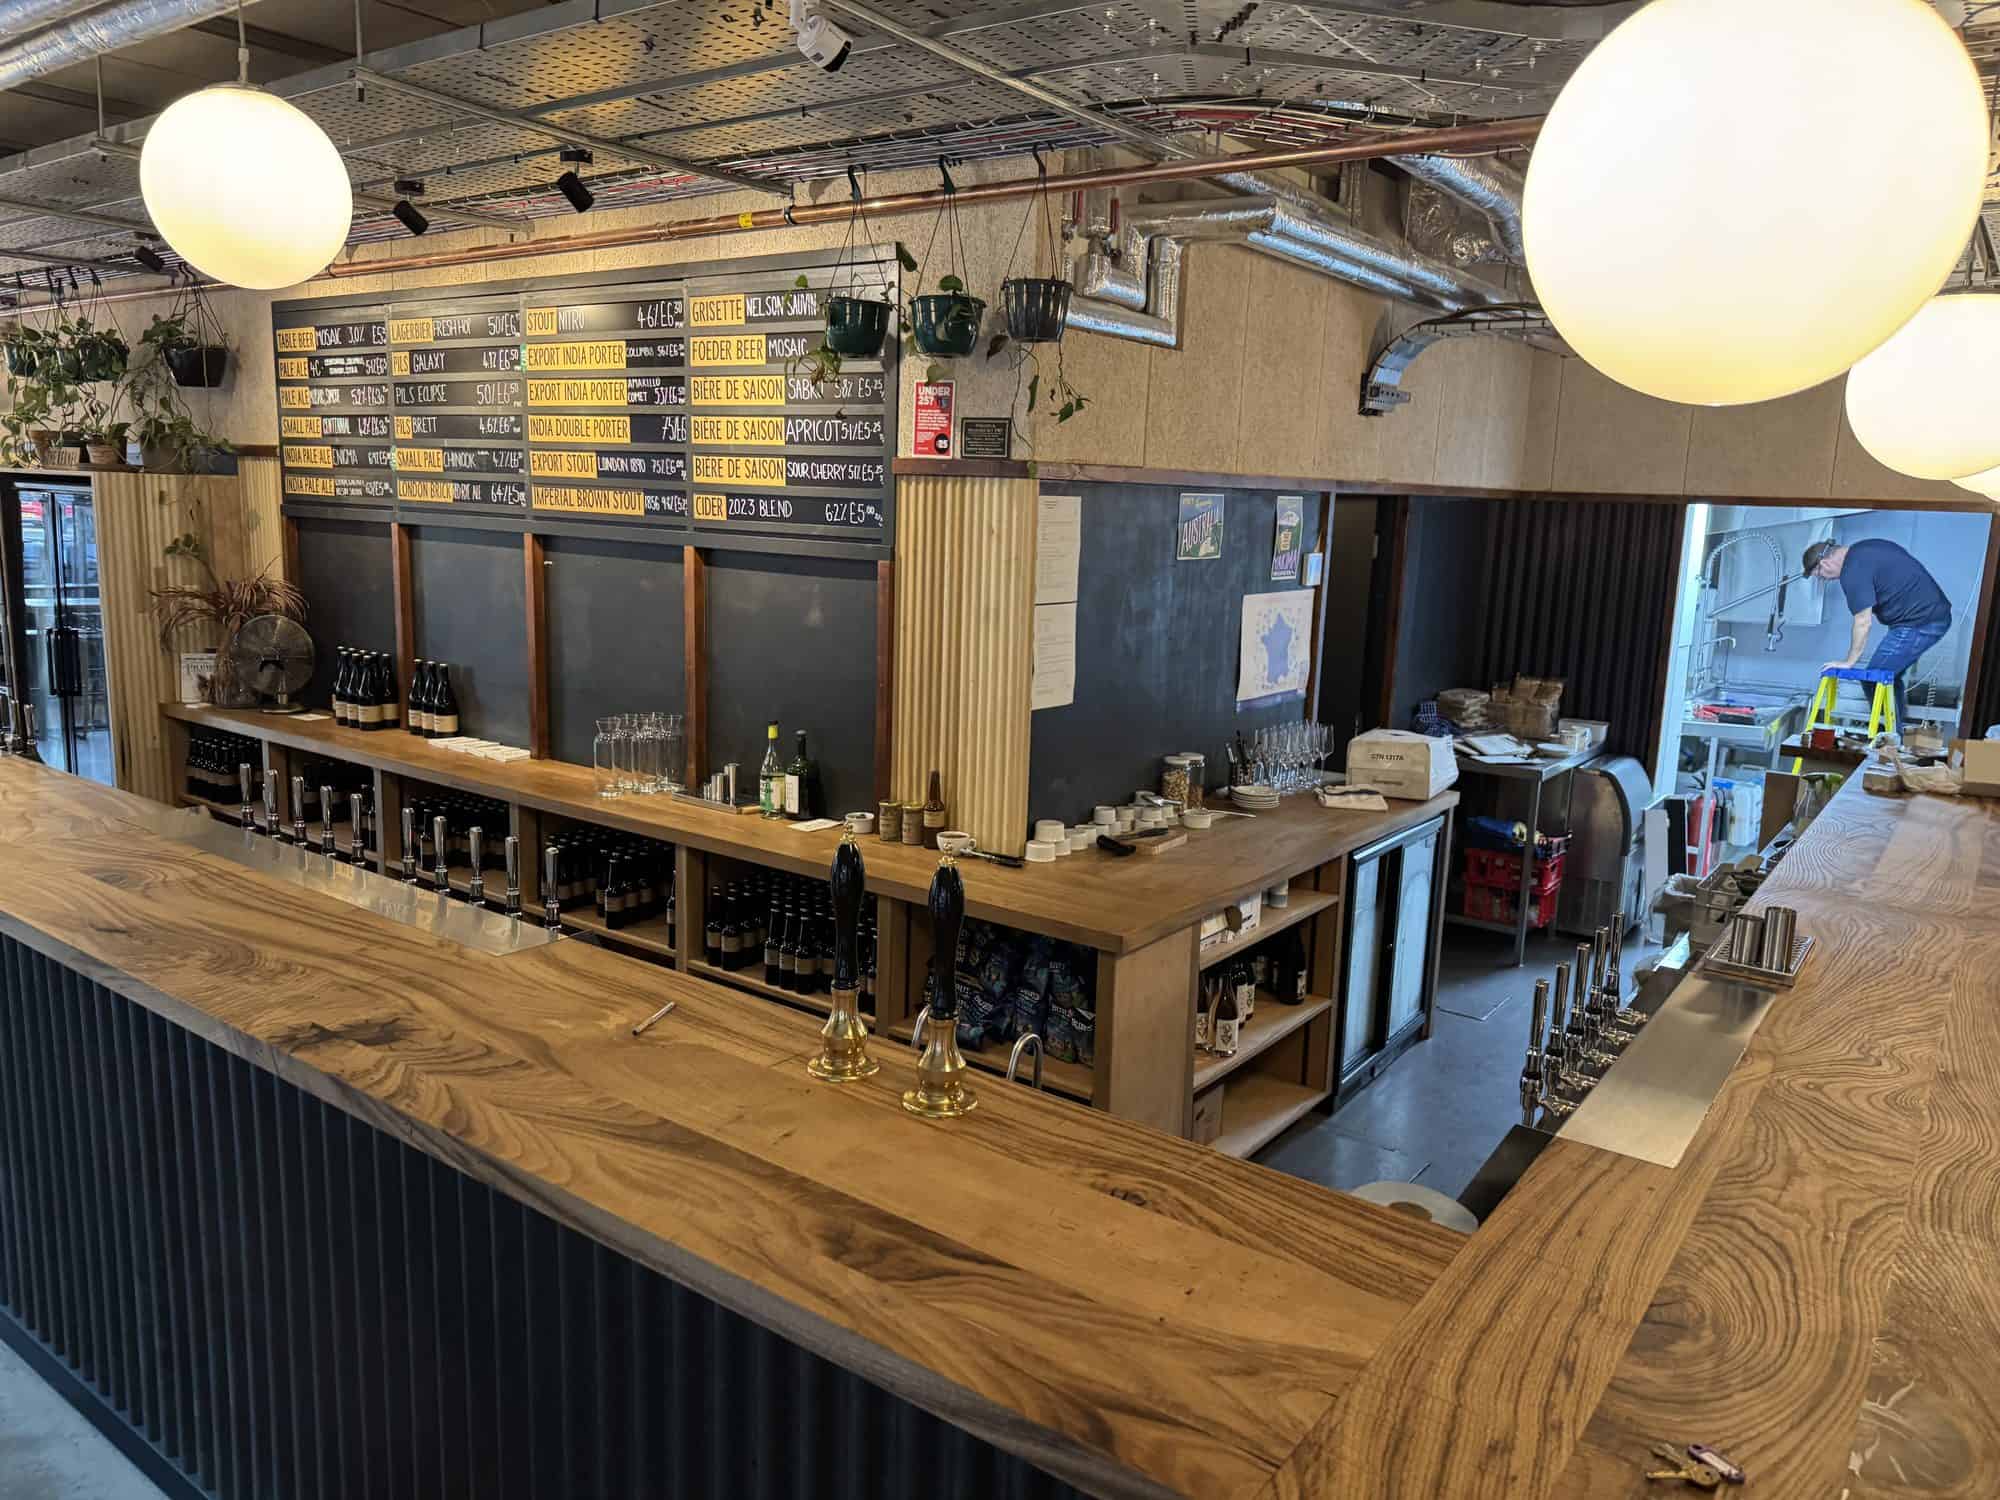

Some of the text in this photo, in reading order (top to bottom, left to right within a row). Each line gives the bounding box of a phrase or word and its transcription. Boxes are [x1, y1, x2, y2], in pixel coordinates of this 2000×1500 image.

[692, 293, 817, 321] GRISETTE NELSON SAUVIN
[528, 311, 554, 331] STOUT
[278, 332, 296, 349] TABLE
[299, 332, 314, 348] BEER
[692, 340, 733, 362] FOEDER
[736, 339, 764, 360] BEER
[394, 356, 409, 373] PILS
[413, 352, 446, 373] GALAXY
[528, 348, 560, 367] EXPORT
[563, 346, 587, 366] INDIA
[590, 345, 624, 365] PORTER
[280, 361, 294, 377] PALE
[296, 361, 308, 376] ALE
[280, 390, 296, 406] PALE
[298, 389, 308, 405] ALE
[395, 386, 416, 404] PILS
[529, 381, 626, 401] EXPORT INDIA PORTER
[726, 379, 740, 400] DE
[743, 378, 783, 400] SAISON
[918, 386, 951, 397] UNDER
[283, 418, 304, 434] SMALL
[306, 418, 322, 434] PALE
[396, 416, 412, 434] PILS
[412, 416, 438, 434] BRETT
[530, 418, 552, 436] INDIA
[556, 418, 590, 438] DOUBLE
[594, 420, 628, 439] PORTER
[726, 420, 740, 441] DE
[744, 420, 783, 441] SAISON
[786, 419, 842, 442] APRICOT
[284, 447, 303, 464] INDIA
[303, 448, 318, 465] PALE
[319, 449, 332, 465] ALE
[398, 450, 423, 468] SMALL
[424, 451, 441, 468] PALE
[532, 453, 563, 472] EXPORT
[567, 454, 594, 473] STOUT
[598, 456, 628, 472] LONDON
[728, 459, 741, 478] DE
[745, 459, 784, 480] SAISON
[787, 462, 810, 480] SOUR
[810, 462, 848, 481] CHERRY
[287, 478, 304, 492] INDIA
[304, 478, 320, 493] PALE
[321, 478, 333, 494] ALE
[400, 480, 428, 498] LONDON
[534, 487, 575, 506] IMPERIAL
[576, 490, 610, 510] BROWN
[613, 492, 642, 512] STOUT
[696, 496, 723, 517] CIDER
[728, 498, 756, 516] 2023
[759, 499, 792, 518] BLEND
